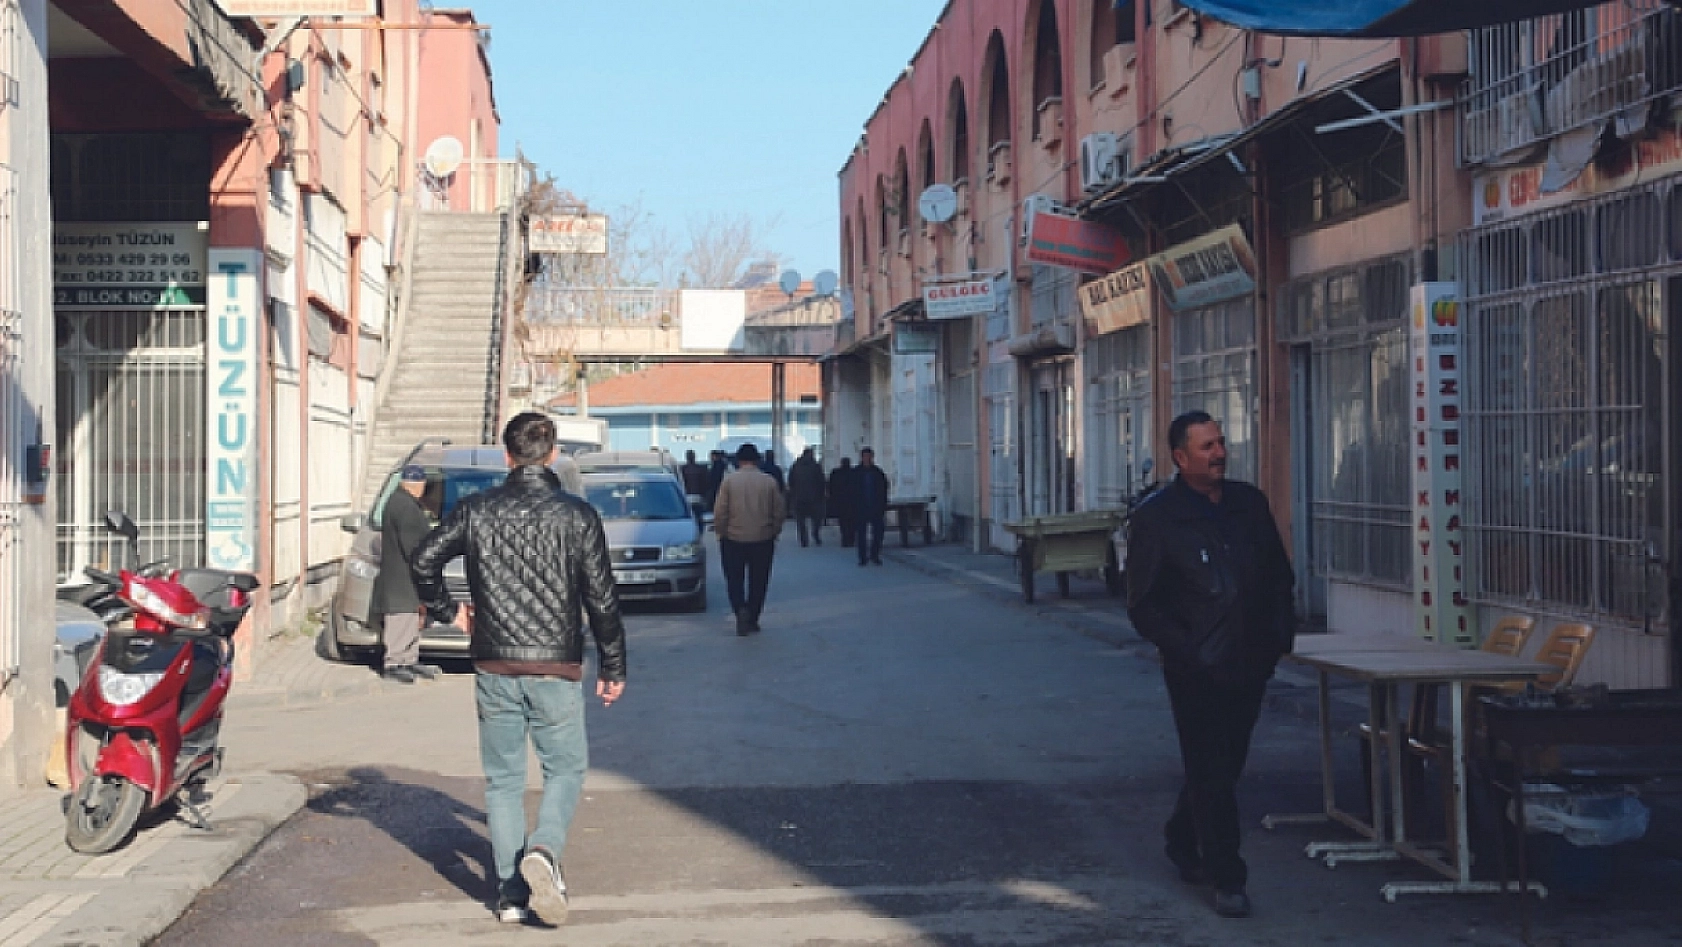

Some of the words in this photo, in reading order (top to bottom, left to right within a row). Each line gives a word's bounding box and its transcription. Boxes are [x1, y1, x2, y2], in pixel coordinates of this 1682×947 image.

[116, 229, 175, 245] TÜZÜN
[77, 253, 113, 265] 0533
[150, 253, 168, 265] 29
[173, 253, 190, 265] 06
[86, 270, 123, 282] 0422
[128, 270, 155, 282] 322
[181, 270, 200, 282] 62
[78, 289, 124, 303] BLOK
[217, 261, 247, 495] TÜZÜN
